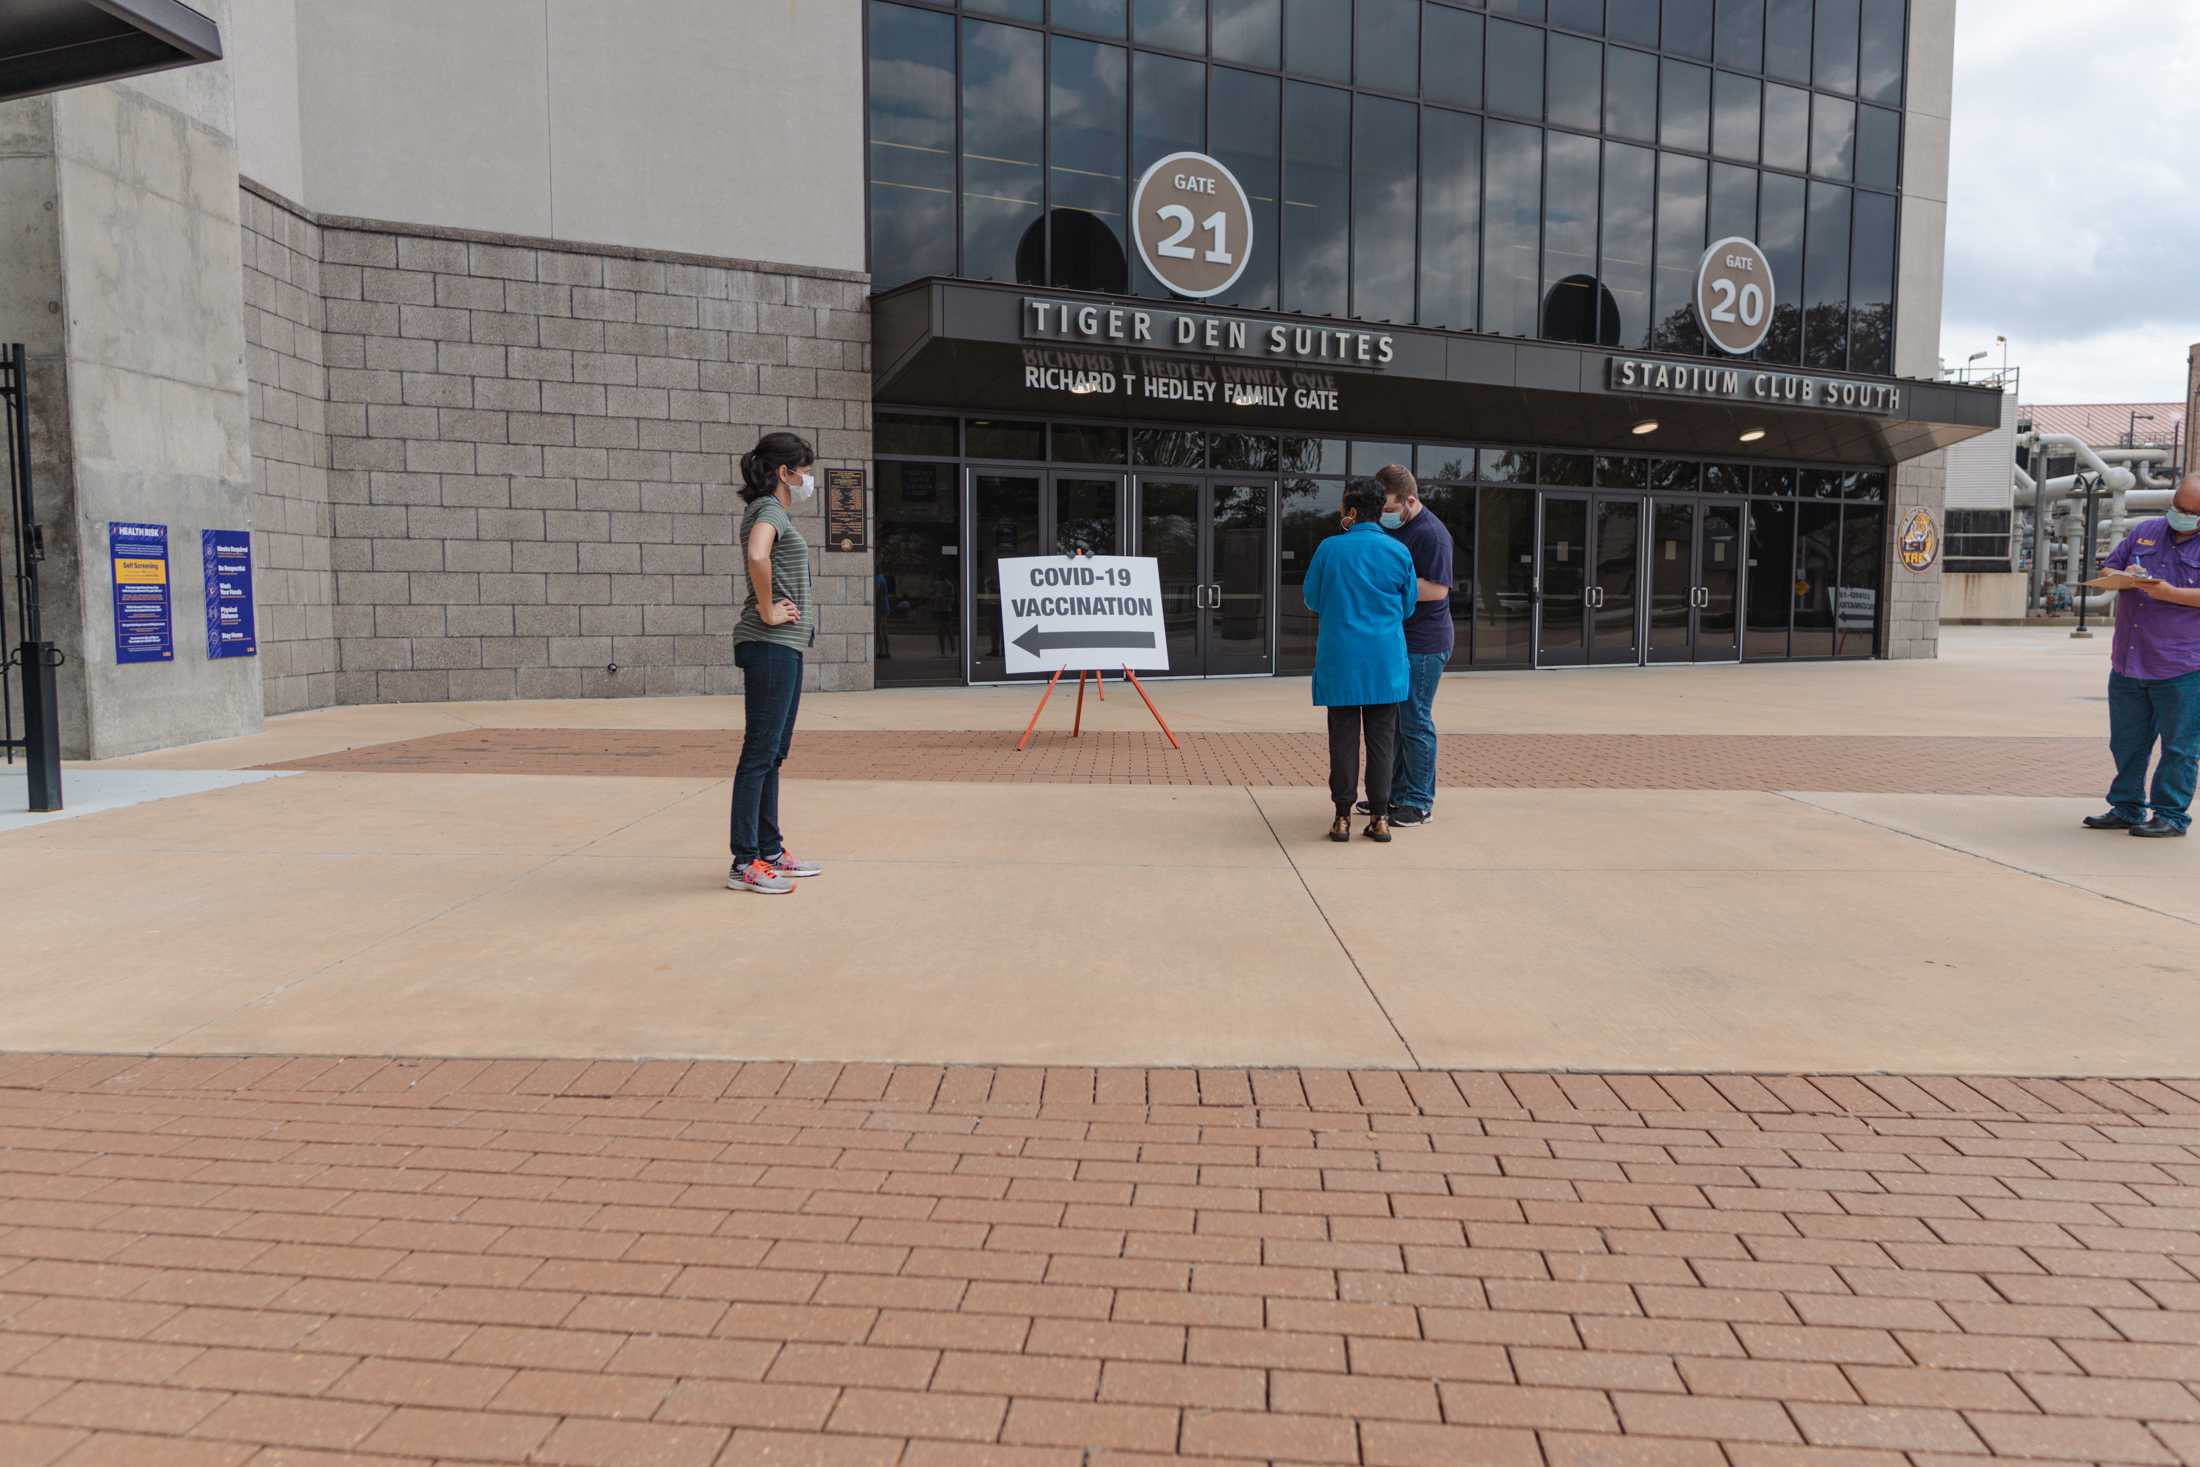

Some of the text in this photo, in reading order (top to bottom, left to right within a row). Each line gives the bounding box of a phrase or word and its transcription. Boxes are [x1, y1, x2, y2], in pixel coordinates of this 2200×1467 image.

[1174, 174, 1216, 195] GATE
[1156, 204, 1232, 265] 21
[1726, 254, 1753, 271] GATE
[1711, 278, 1764, 327] 20
[1032, 302, 1393, 363] TIGER DEN SUITES
[1025, 366, 1339, 411] RICHARD T HEDLEY FAMILY GATE
[1622, 361, 1899, 410] STADIUM CLUB SOUTH
[119, 527, 159, 537] HEALTH RISK
[1030, 567, 1131, 587] COVID-19
[1011, 597, 1153, 617] VACCINATION
